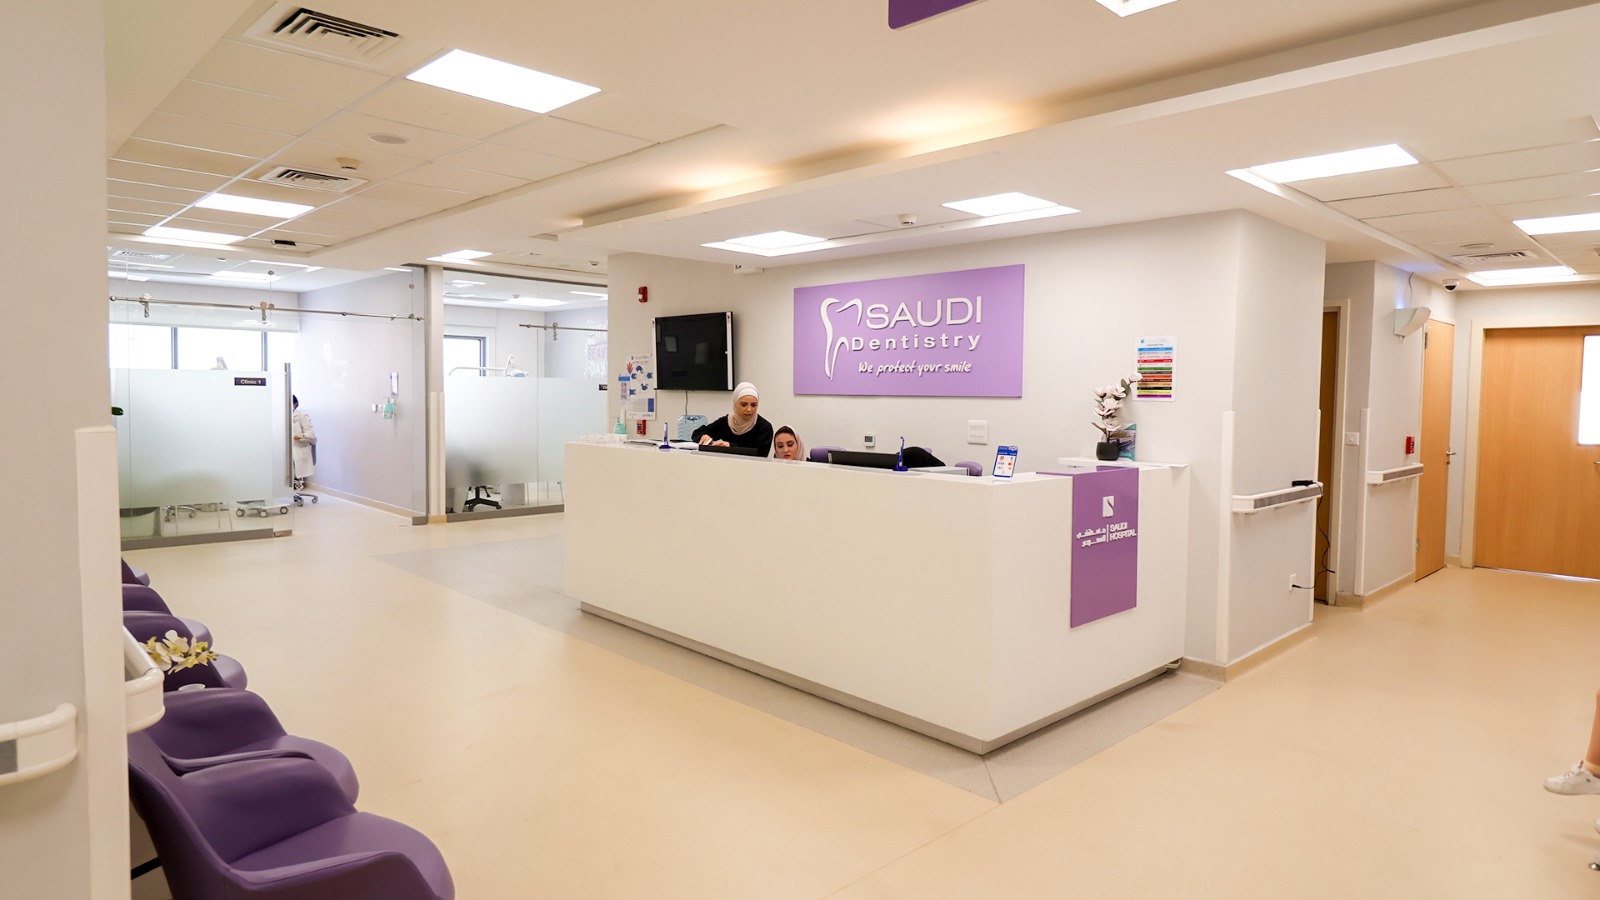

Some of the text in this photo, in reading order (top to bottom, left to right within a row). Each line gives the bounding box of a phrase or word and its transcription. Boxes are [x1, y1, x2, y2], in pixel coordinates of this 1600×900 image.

[866, 295, 982, 330] SAUDI
[852, 333, 982, 351] Dentistry
[858, 360, 972, 377] We protect your smile
[1109, 522, 1128, 532] SAUDI
[1109, 529, 1137, 541] HOSPITAL
